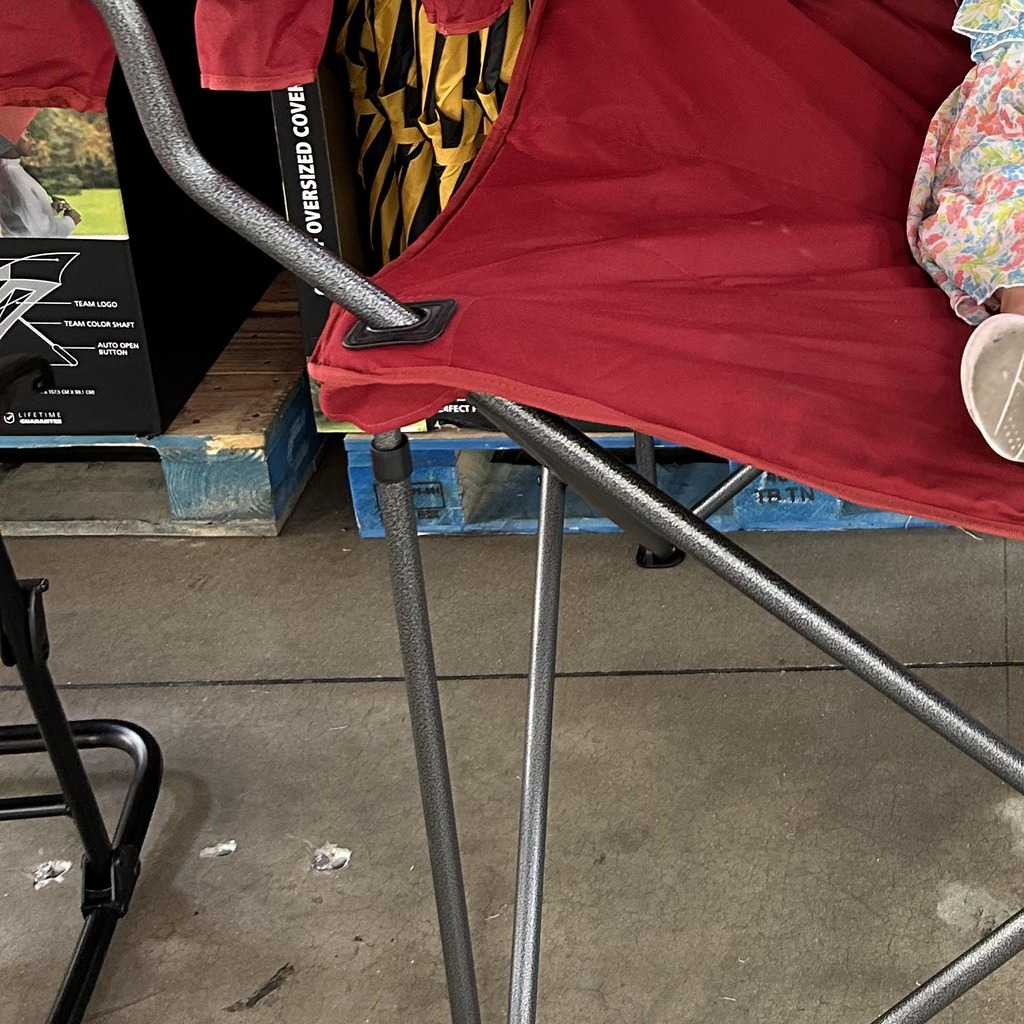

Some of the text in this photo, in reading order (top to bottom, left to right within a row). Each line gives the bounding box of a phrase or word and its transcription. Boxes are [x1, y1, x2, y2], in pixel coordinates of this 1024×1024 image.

[295, 142, 323, 234] OVERSIZED
[74, 300, 118, 308] TEAM LOGO
[87, 320, 111, 328] COLOR
